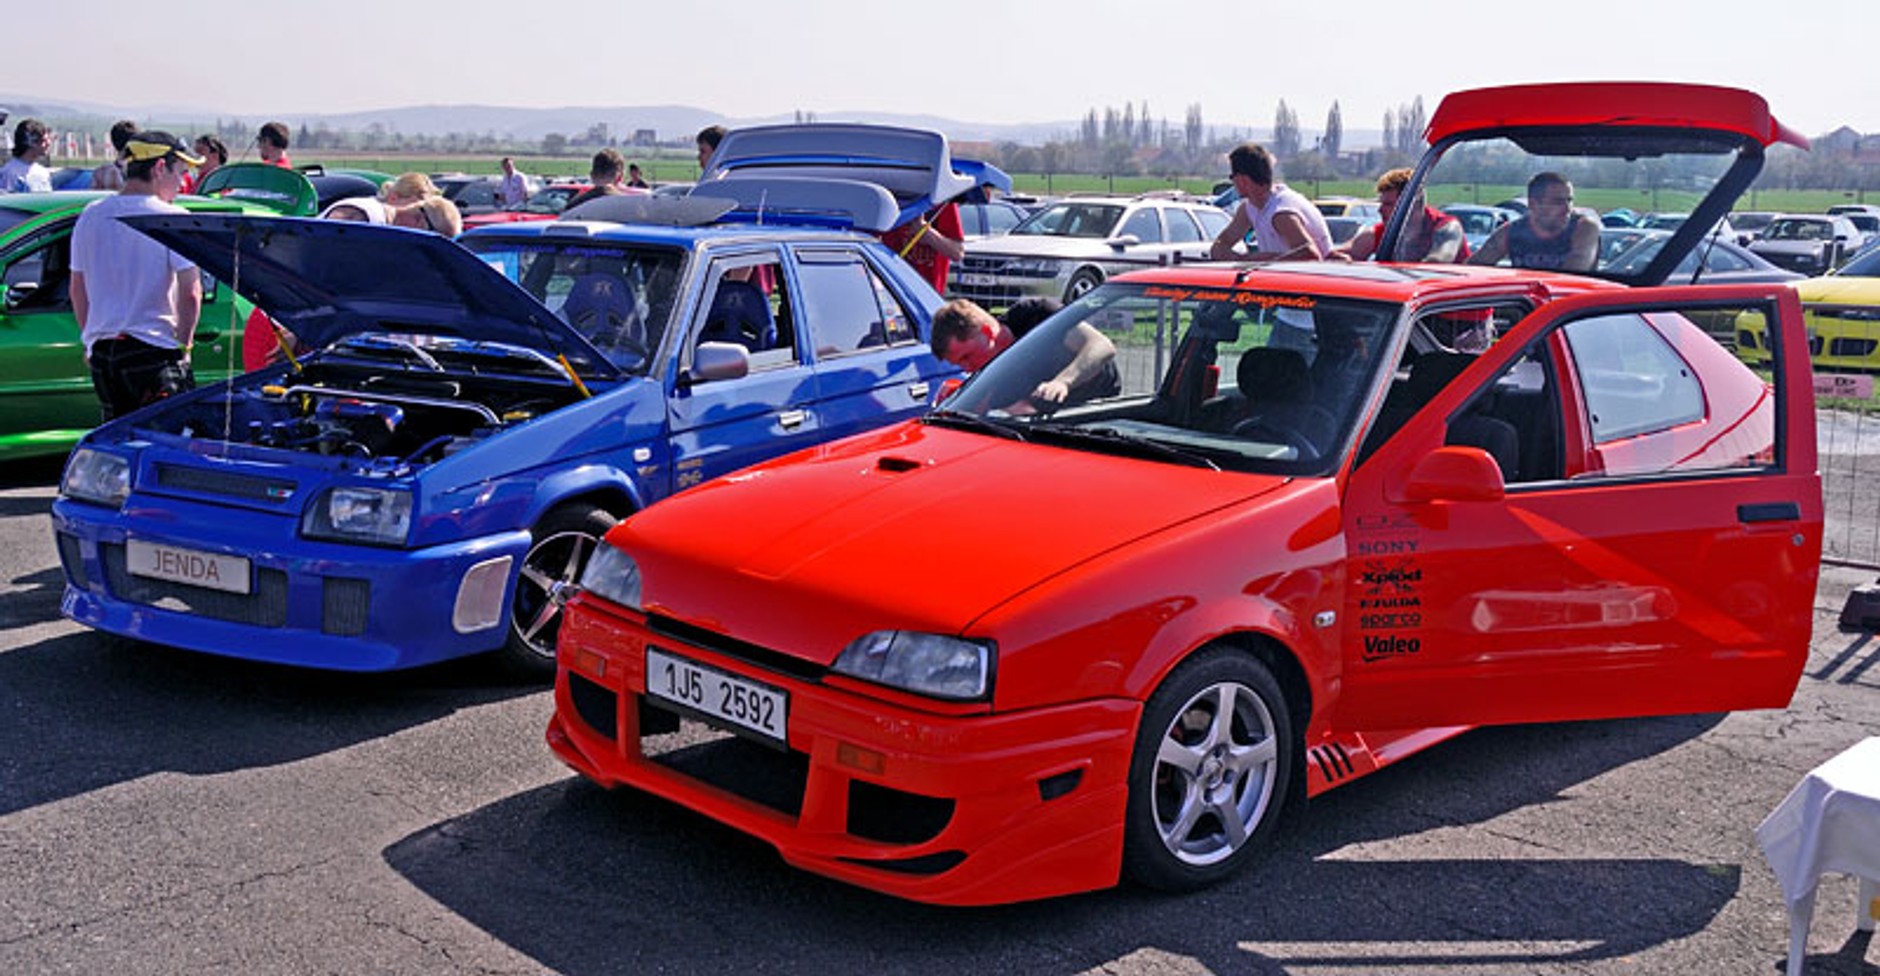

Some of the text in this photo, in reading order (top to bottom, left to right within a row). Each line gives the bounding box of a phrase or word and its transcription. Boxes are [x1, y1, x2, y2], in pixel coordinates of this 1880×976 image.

[1359, 540, 1419, 555] SONY
[153, 548, 220, 582] JENDA
[1364, 635, 1421, 653] Valeo
[665, 662, 775, 732] 1J5 2592
